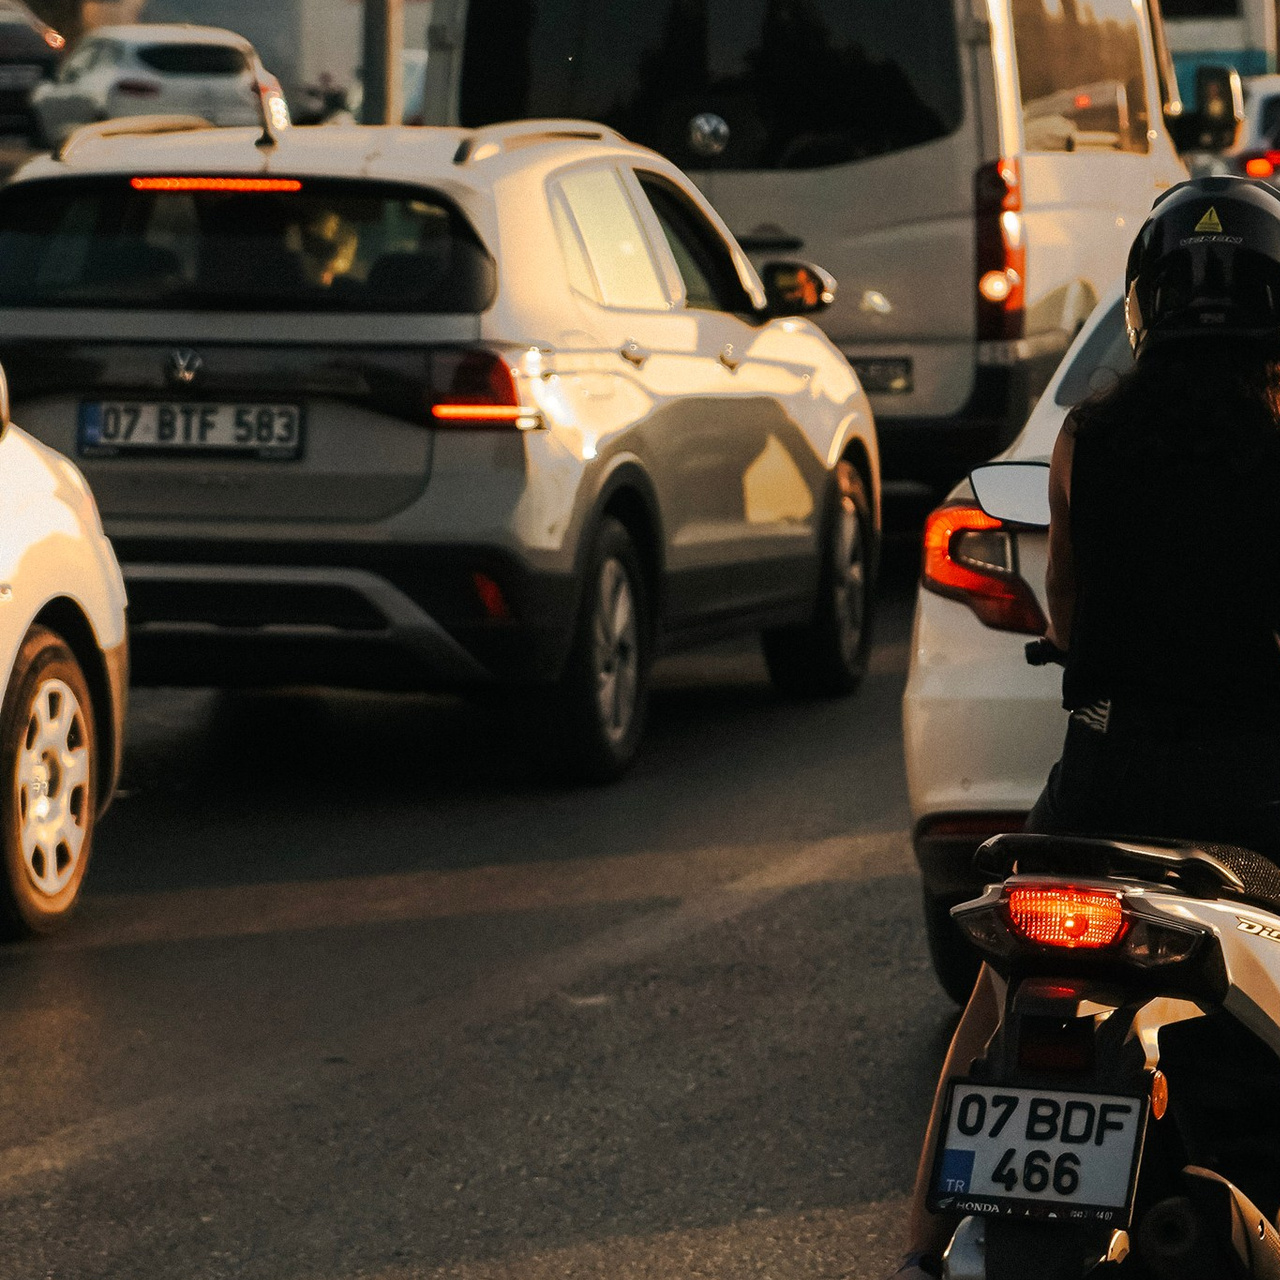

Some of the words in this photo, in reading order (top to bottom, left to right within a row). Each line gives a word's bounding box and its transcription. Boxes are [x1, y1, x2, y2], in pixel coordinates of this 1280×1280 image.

[102, 406, 142, 442] 07
[158, 405, 219, 442] BTF
[233, 407, 296, 443] 583
[956, 1093, 1020, 1138] 07
[1025, 1097, 1133, 1146] BDF
[946, 1179, 965, 1194] TR
[991, 1147, 1082, 1196] 466
[956, 1201, 1001, 1214] HONDA
